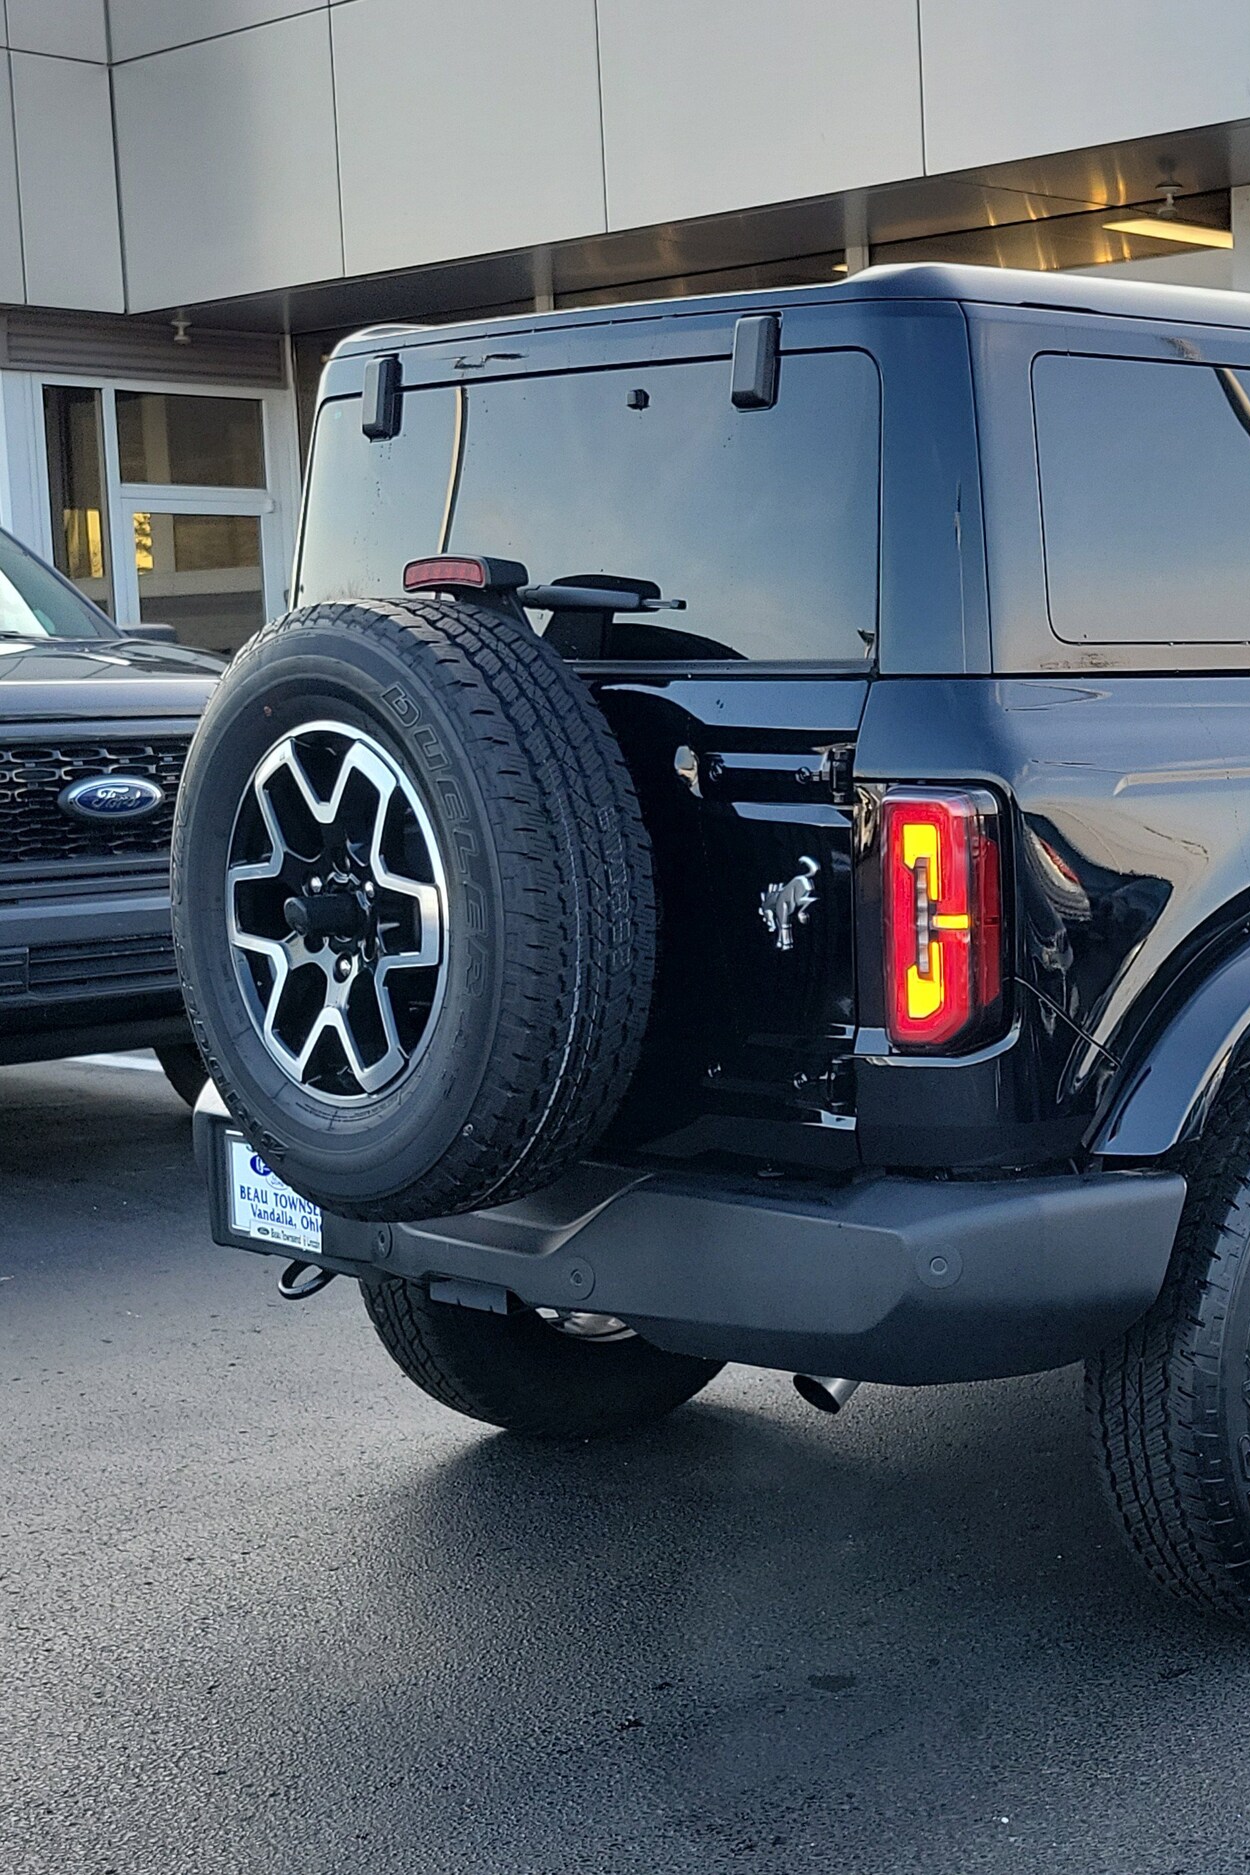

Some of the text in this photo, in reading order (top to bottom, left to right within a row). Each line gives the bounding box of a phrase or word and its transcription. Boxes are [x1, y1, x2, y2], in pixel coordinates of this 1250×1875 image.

[91, 786, 141, 808] Ford
[382, 682, 488, 998] DUELER
[239, 1184, 322, 1217] BEAU TOWNSE
